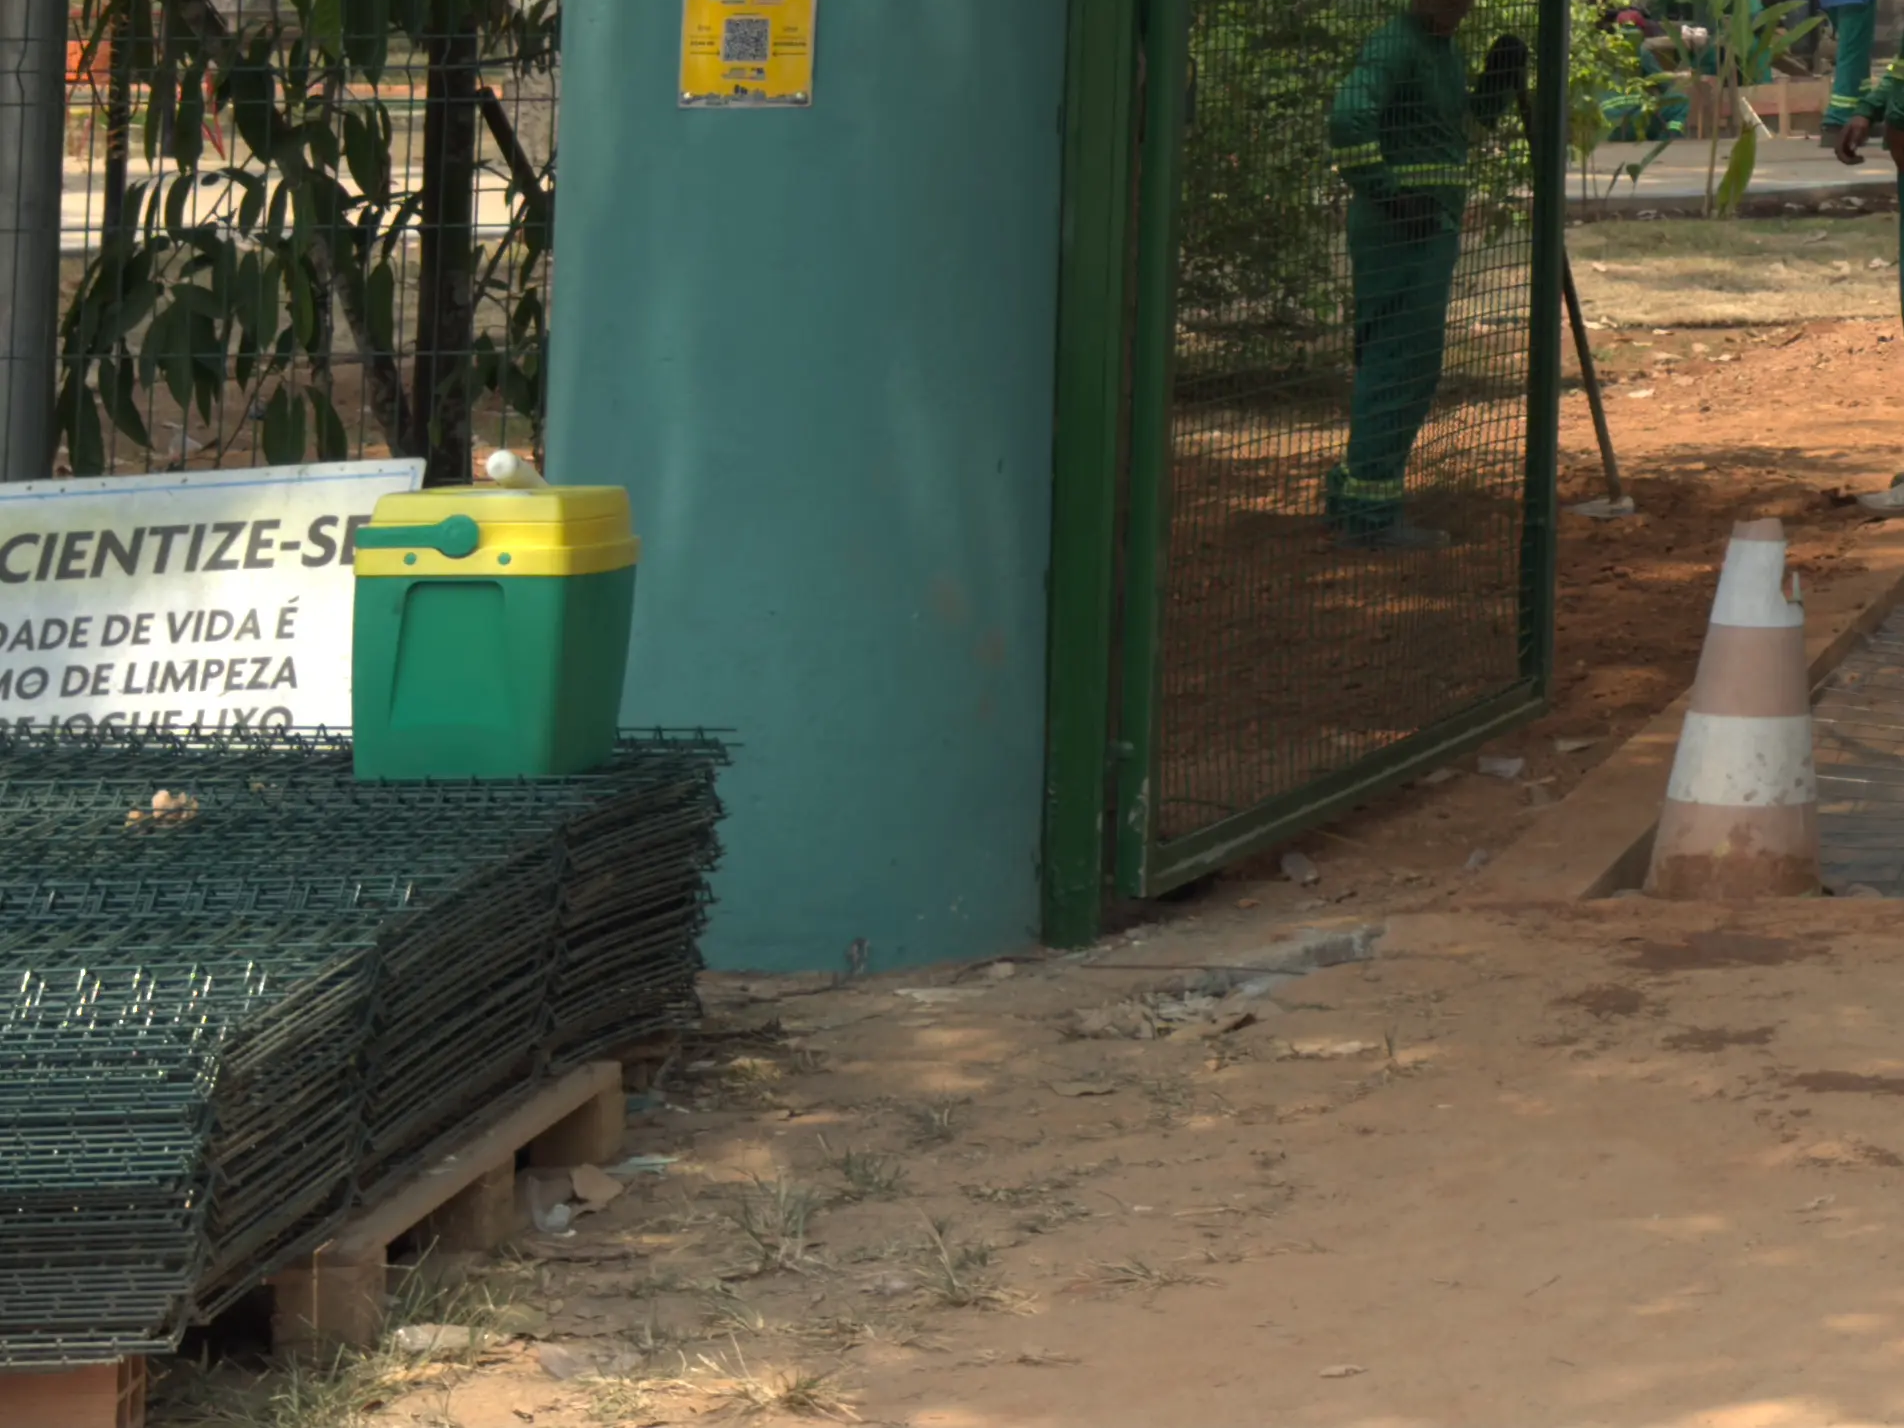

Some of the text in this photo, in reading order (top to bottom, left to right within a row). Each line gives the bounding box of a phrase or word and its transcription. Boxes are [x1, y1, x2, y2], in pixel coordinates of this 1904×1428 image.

[101, 613, 155, 647] DE
[167, 608, 261, 643] VIDA
[275, 595, 299, 640] É
[59, 663, 114, 697] DE
[122, 656, 298, 695] LIMPEZA
